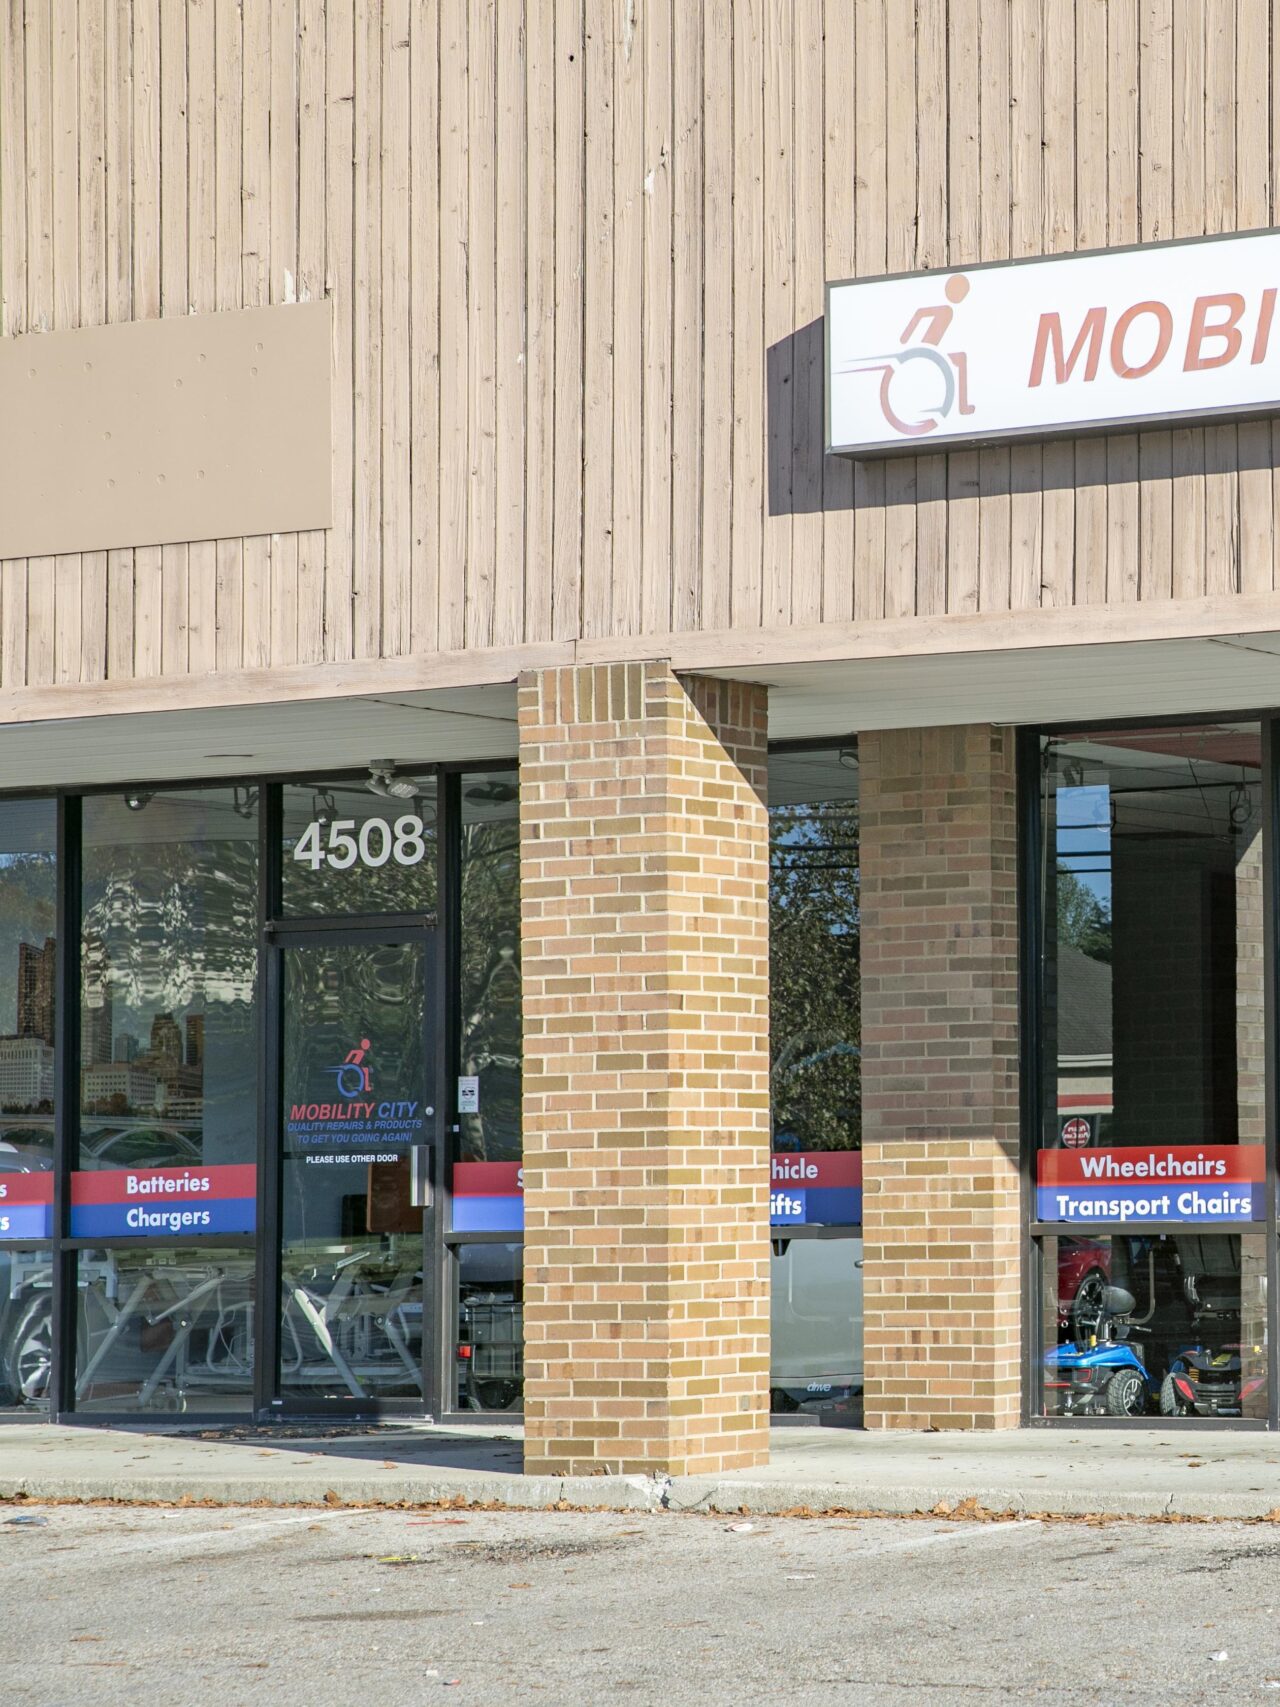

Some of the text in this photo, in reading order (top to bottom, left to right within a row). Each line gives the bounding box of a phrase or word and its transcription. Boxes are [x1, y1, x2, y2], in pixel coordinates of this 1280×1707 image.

[293, 814, 426, 870] 4508
[290, 1101, 418, 1120] MOBILITY CITY
[288, 1119, 422, 1132] QUALITY REPAIRS & PRODUCTS
[297, 1132, 413, 1144] TO GET YOU GOING AGAIN!
[306, 1154, 398, 1164] PLEASE USE OTHER DOOR
[772, 1158, 818, 1179] hicle
[1080, 1153, 1227, 1178] Wheelchairs
[126, 1172, 210, 1194] Batteries
[770, 1193, 802, 1215] ifts
[1056, 1191, 1253, 1221] Transport Chairs
[126, 1207, 210, 1231] Chargers
[807, 1382, 831, 1392] drive
